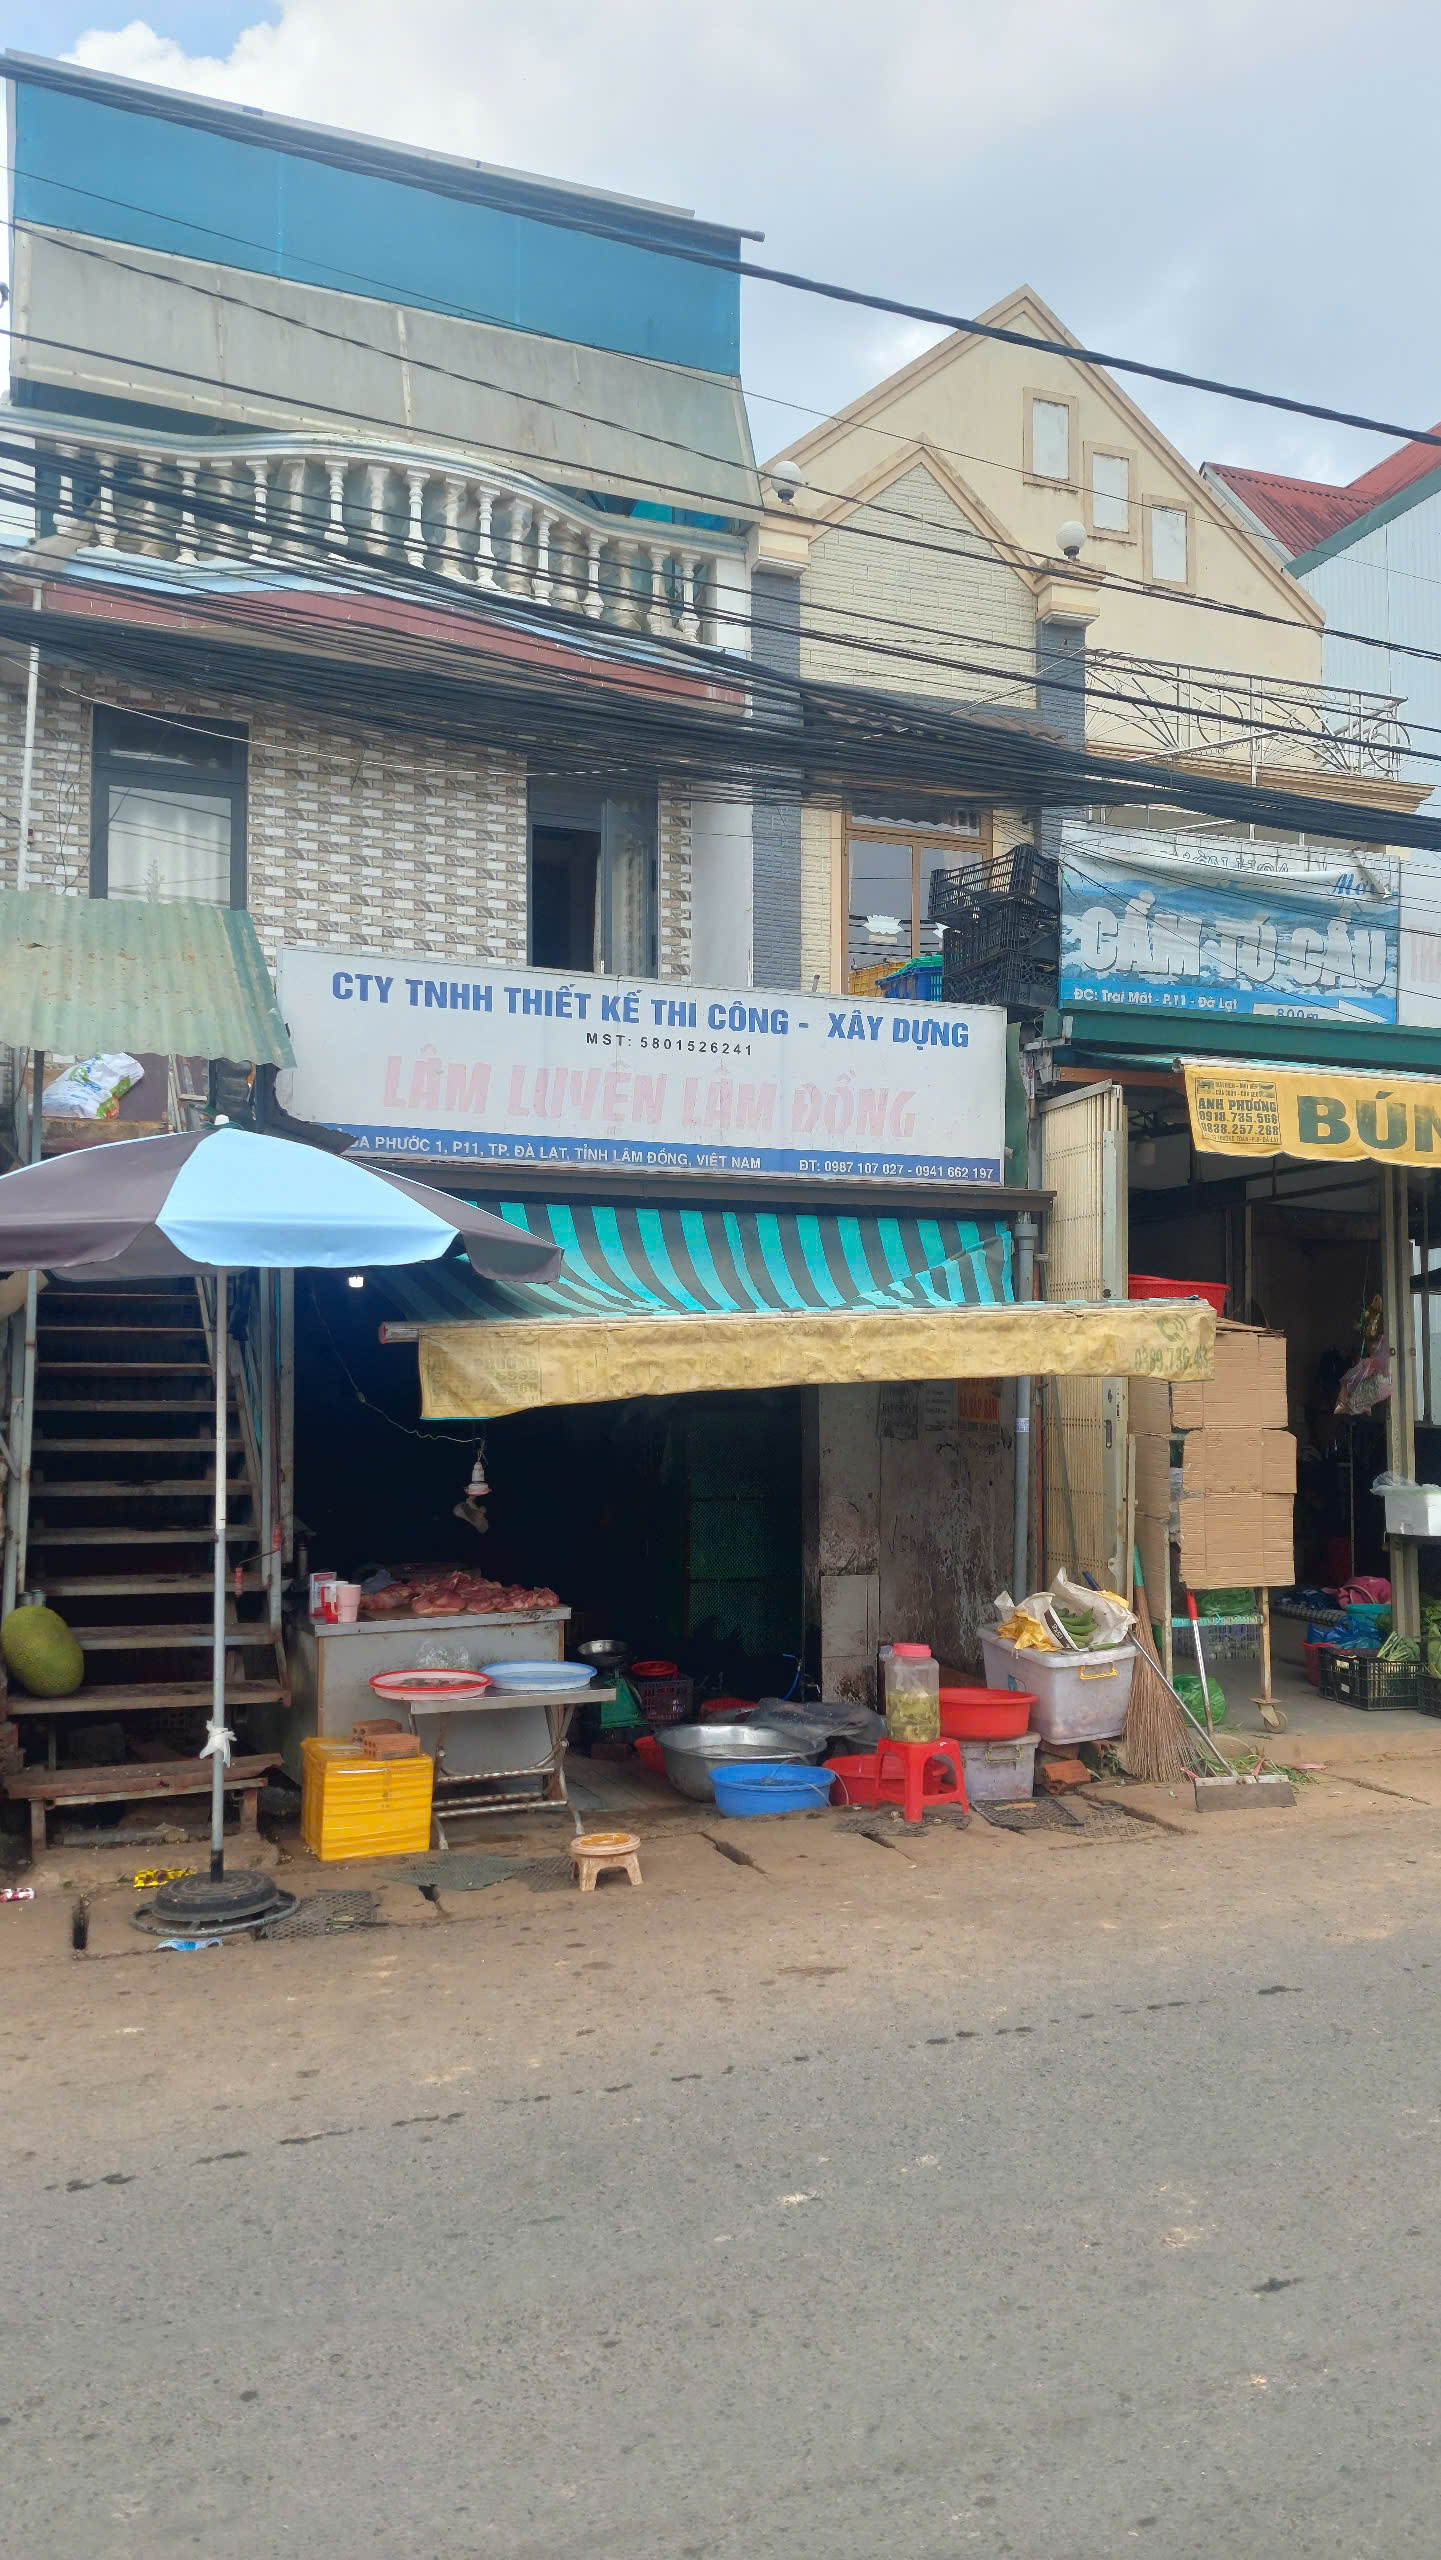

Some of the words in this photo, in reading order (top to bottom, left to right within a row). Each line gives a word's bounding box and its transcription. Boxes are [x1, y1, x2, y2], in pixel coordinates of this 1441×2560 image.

[332, 971, 395, 1004] CTY
[405, 978, 494, 1013] TNHH
[504, 983, 592, 1020] THIẾT
[601, 988, 643, 1024] KẾ
[651, 999, 698, 1028] THI
[707, 1000, 789, 1035] CÔNG
[828, 1009, 884, 1041] XÂY
[892, 1017, 970, 1051] DỰNG
[586, 1031, 632, 1048] MST:
[640, 1036, 752, 1056] 5801526241
[384, 1043, 491, 1114] LÂM
[507, 1059, 668, 1136] LUYỆN
[682, 1062, 778, 1130] LÂM
[792, 1064, 917, 1138] ĐỒNG
[1198, 1097, 1224, 1110] ANH
[488, 1143, 510, 1158] TP.
[514, 1143, 535, 1159] ĐÀ
[574, 1143, 608, 1162] TỈNH
[613, 1147, 643, 1163] LÂM
[731, 1156, 761, 1169] NAM
[799, 1159, 821, 1172] ĐT:
[824, 1160, 854, 1173] 0987
[858, 1162, 878, 1174] 107
[882, 1163, 905, 1175] 027
[915, 1164, 944, 1177] 0941
[947, 1166, 969, 1178] 662
[972, 1167, 994, 1179] 197
